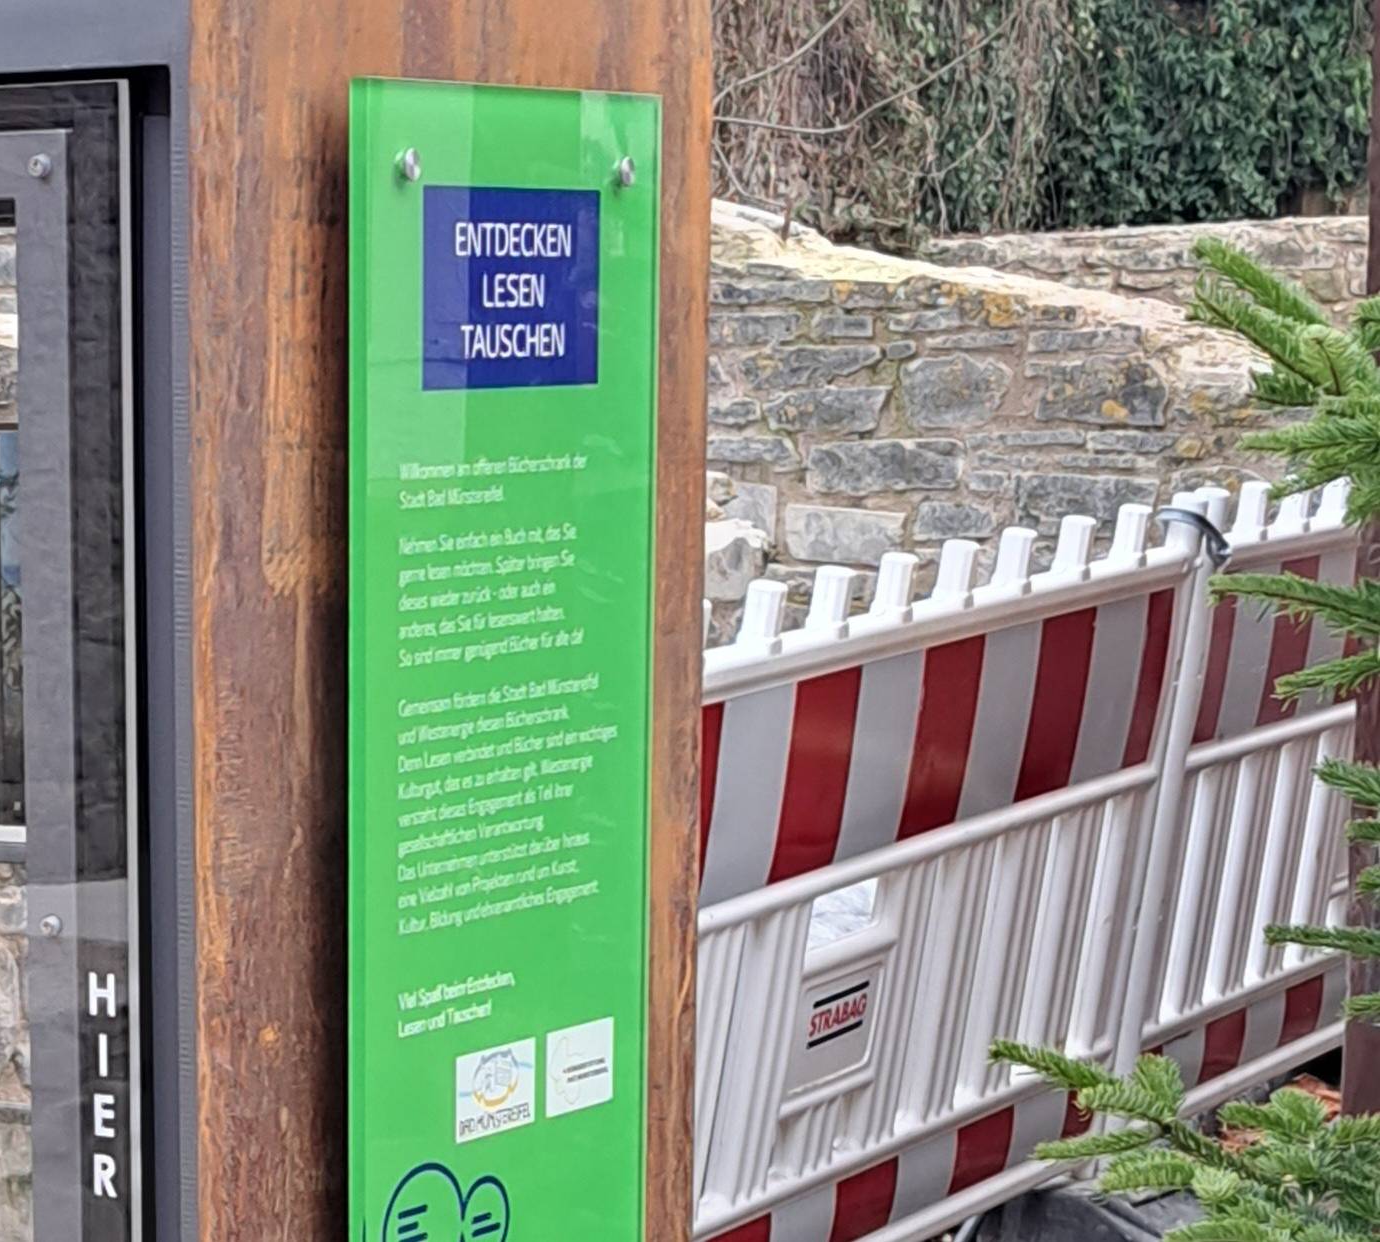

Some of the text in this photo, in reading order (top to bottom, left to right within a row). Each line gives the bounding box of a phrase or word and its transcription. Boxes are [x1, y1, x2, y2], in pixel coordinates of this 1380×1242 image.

[455, 221, 572, 258] ENTDECKEN
[482, 272, 544, 308] LESEN
[460, 323, 565, 359] TAUSCHEN
[399, 490, 426, 509] Stadt
[427, 489, 446, 507] Bad
[439, 534, 454, 551] Sie
[504, 528, 526, 545] Buch
[562, 522, 577, 540] Sie
[560, 549, 575, 566] Sie
[399, 648, 413, 668] So
[399, 992, 417, 1011] Viel
[809, 992, 867, 1038] STRABAG
[398, 1020, 426, 1038] Lesen
[427, 1010, 446, 1031] und
[88, 971, 117, 1198] HIER
